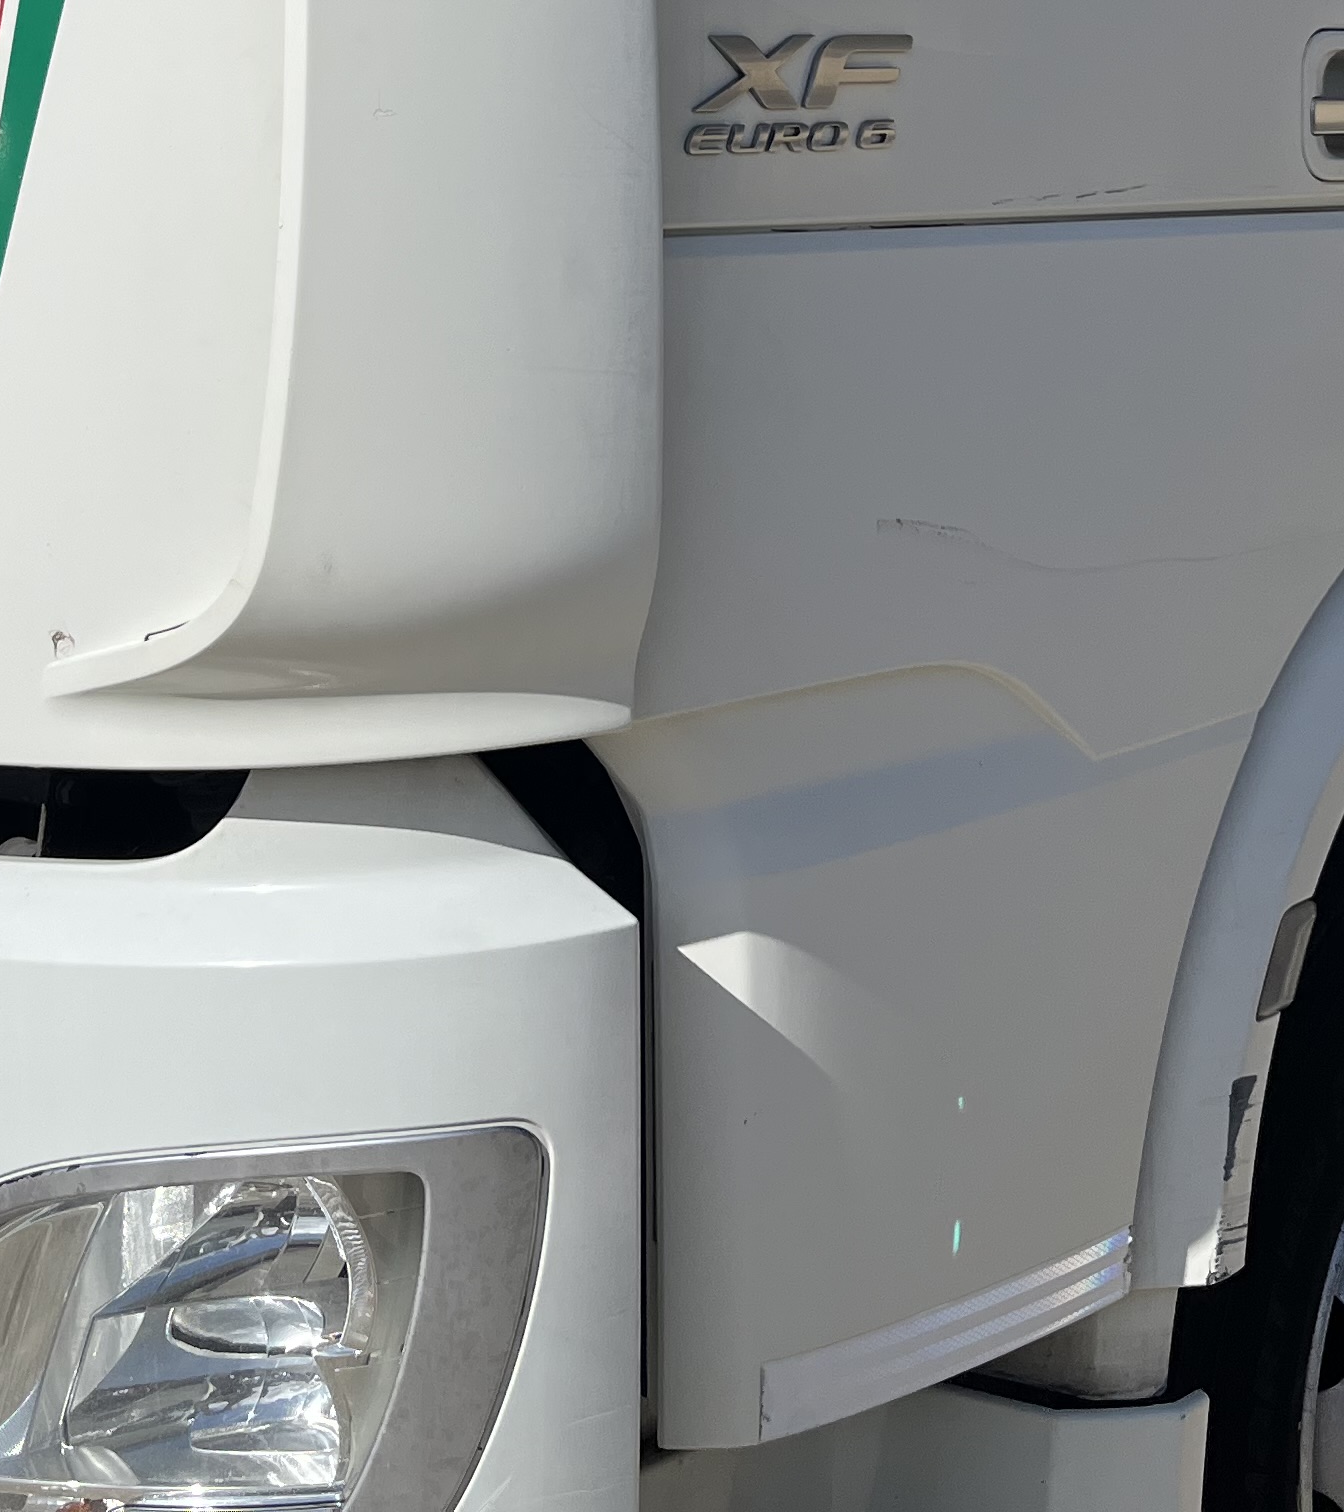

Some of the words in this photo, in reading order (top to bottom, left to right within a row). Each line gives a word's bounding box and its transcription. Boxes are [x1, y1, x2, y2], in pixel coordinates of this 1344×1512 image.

[690, 33, 915, 114] XF
[683, 120, 850, 156] EURO
[855, 118, 897, 150] 6
